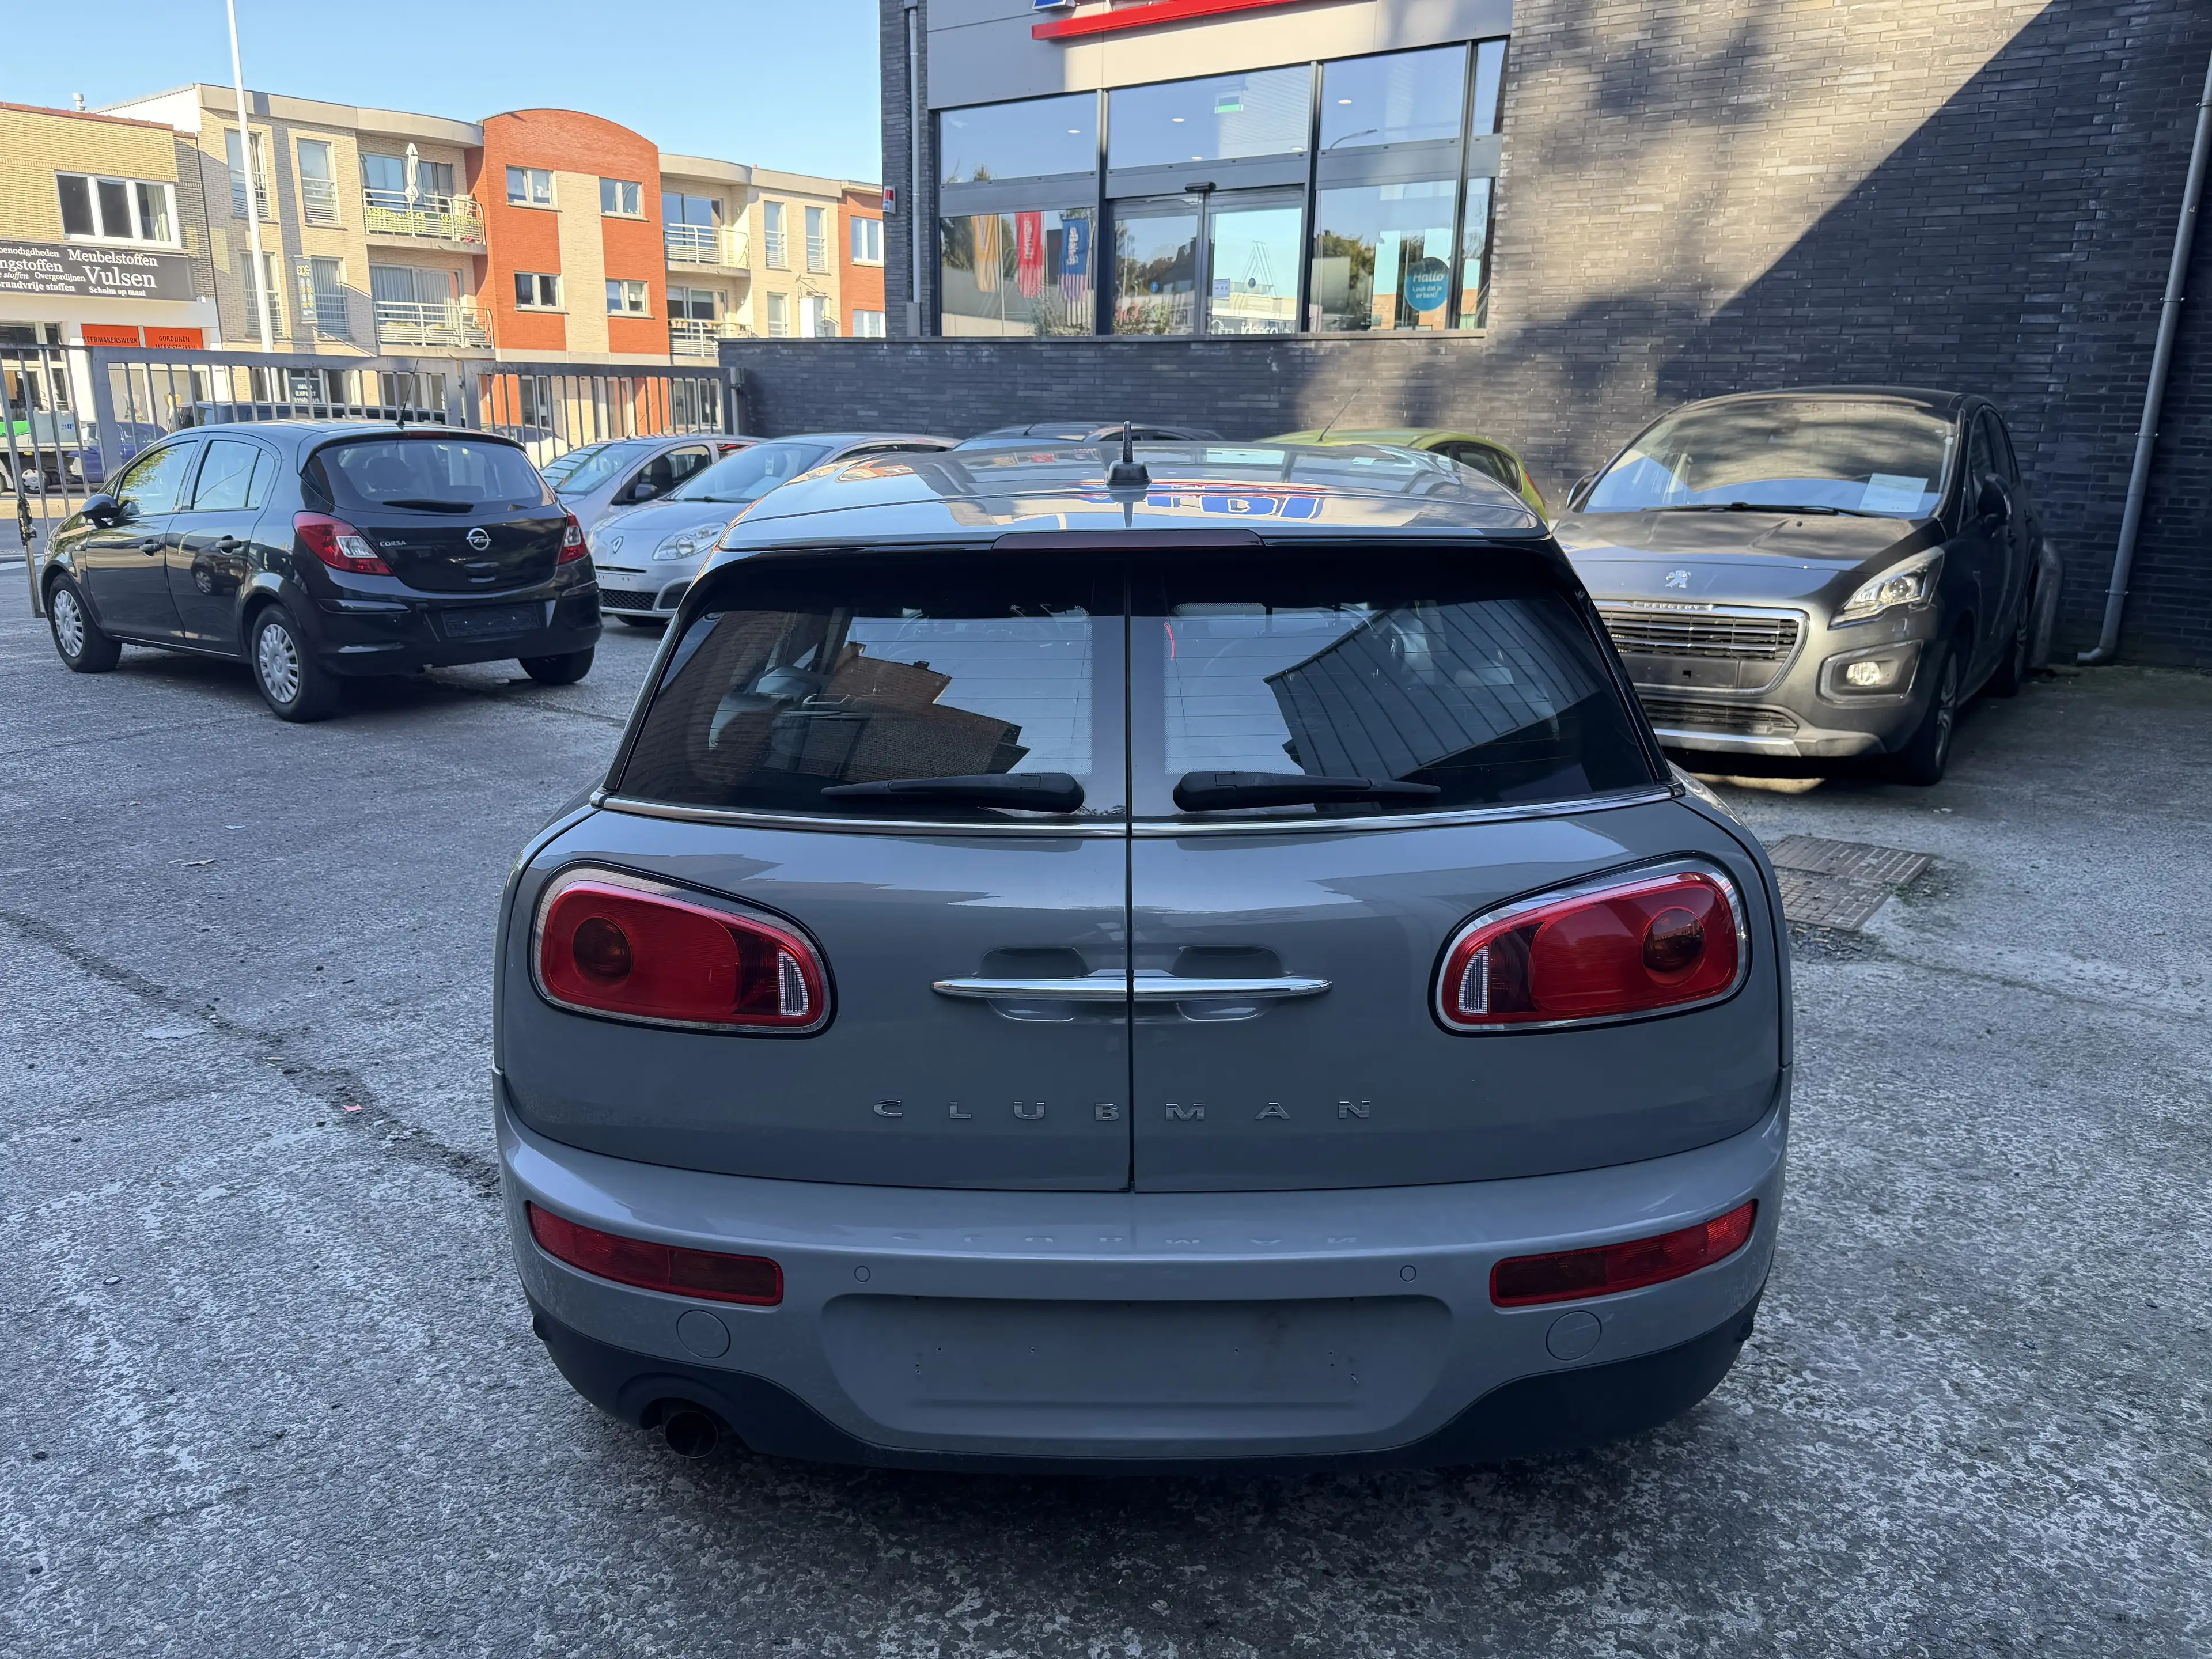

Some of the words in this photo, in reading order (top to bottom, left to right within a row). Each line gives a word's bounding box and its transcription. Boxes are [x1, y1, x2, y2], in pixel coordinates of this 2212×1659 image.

[67, 249, 158, 267] Meubelstoffen
[3, 271, 29, 281] stoffen
[35, 272, 86, 282] Overgordijnen
[82, 266, 158, 288] Vulsen
[1412, 271, 1446, 282] Hallo
[0, 281, 44, 292] randvrije
[46, 283, 75, 292] stoffen
[89, 286, 116, 295] Schuim
[873, 1099, 1371, 1122] CLUBMAN
